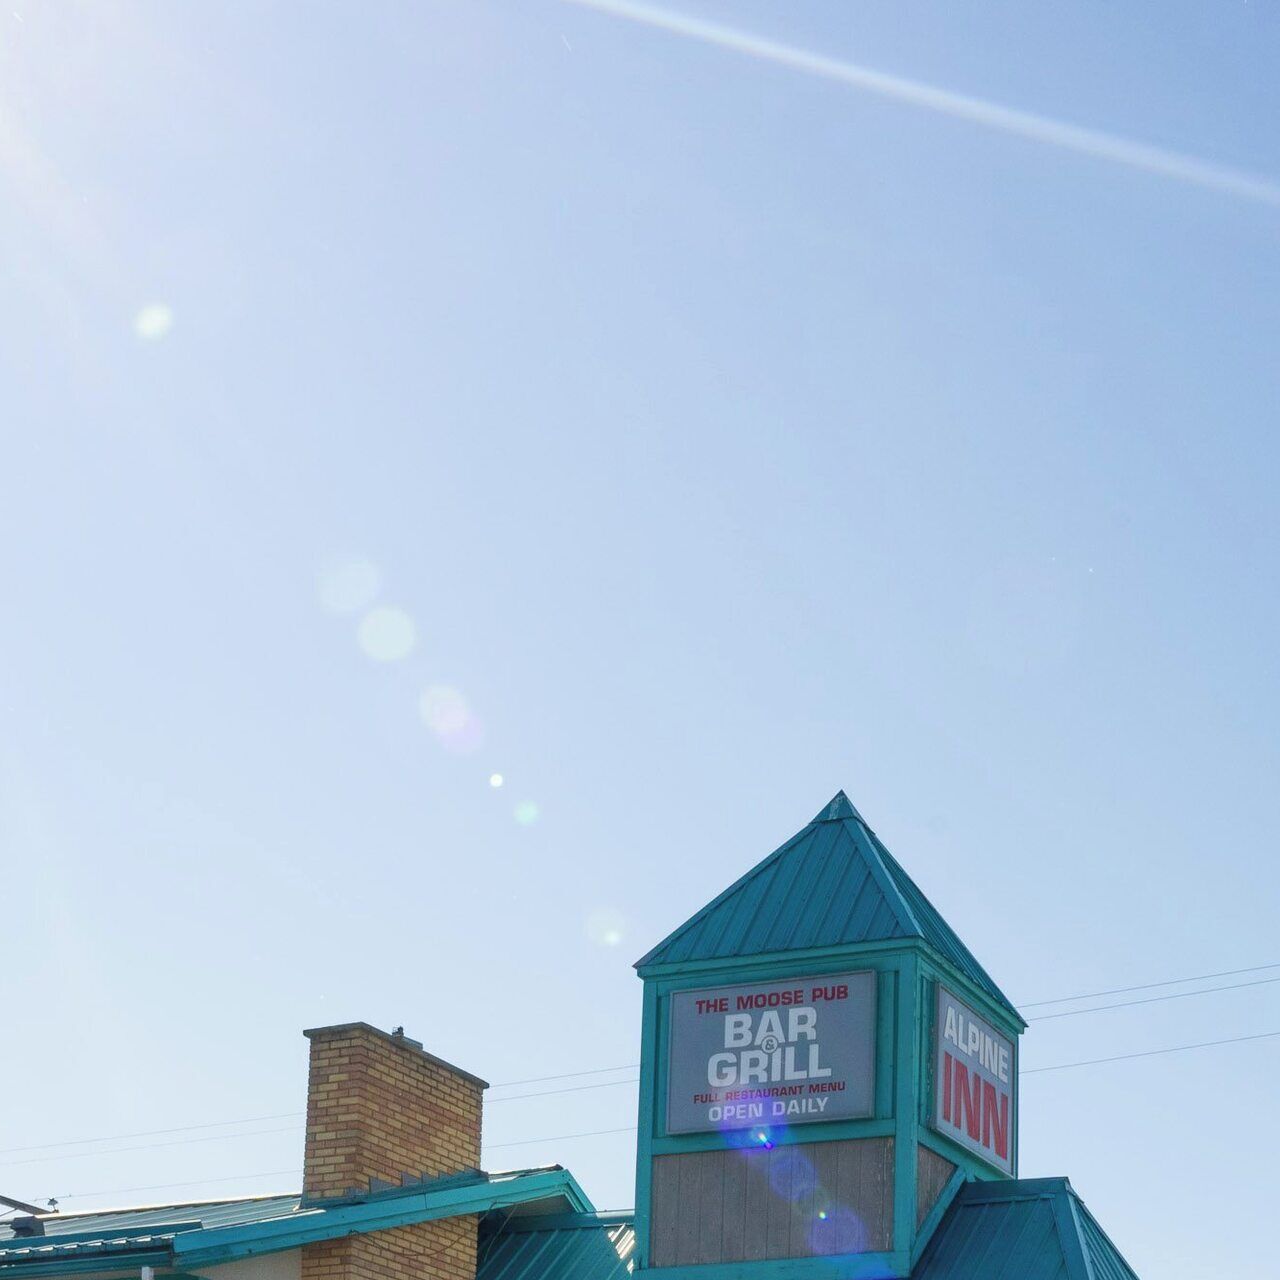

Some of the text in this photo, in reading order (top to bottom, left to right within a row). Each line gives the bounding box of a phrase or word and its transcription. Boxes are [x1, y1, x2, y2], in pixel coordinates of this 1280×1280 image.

[696, 985, 849, 1015] THE MOOSE PUB
[724, 1006, 817, 1048] BAR
[944, 1005, 1009, 1084] ALPINE
[707, 1043, 832, 1088] GRILL
[693, 1081, 846, 1105] FULL RESTAURANT MENU
[708, 1097, 829, 1122] OPEN DAILY
[943, 1051, 1008, 1161] INN
